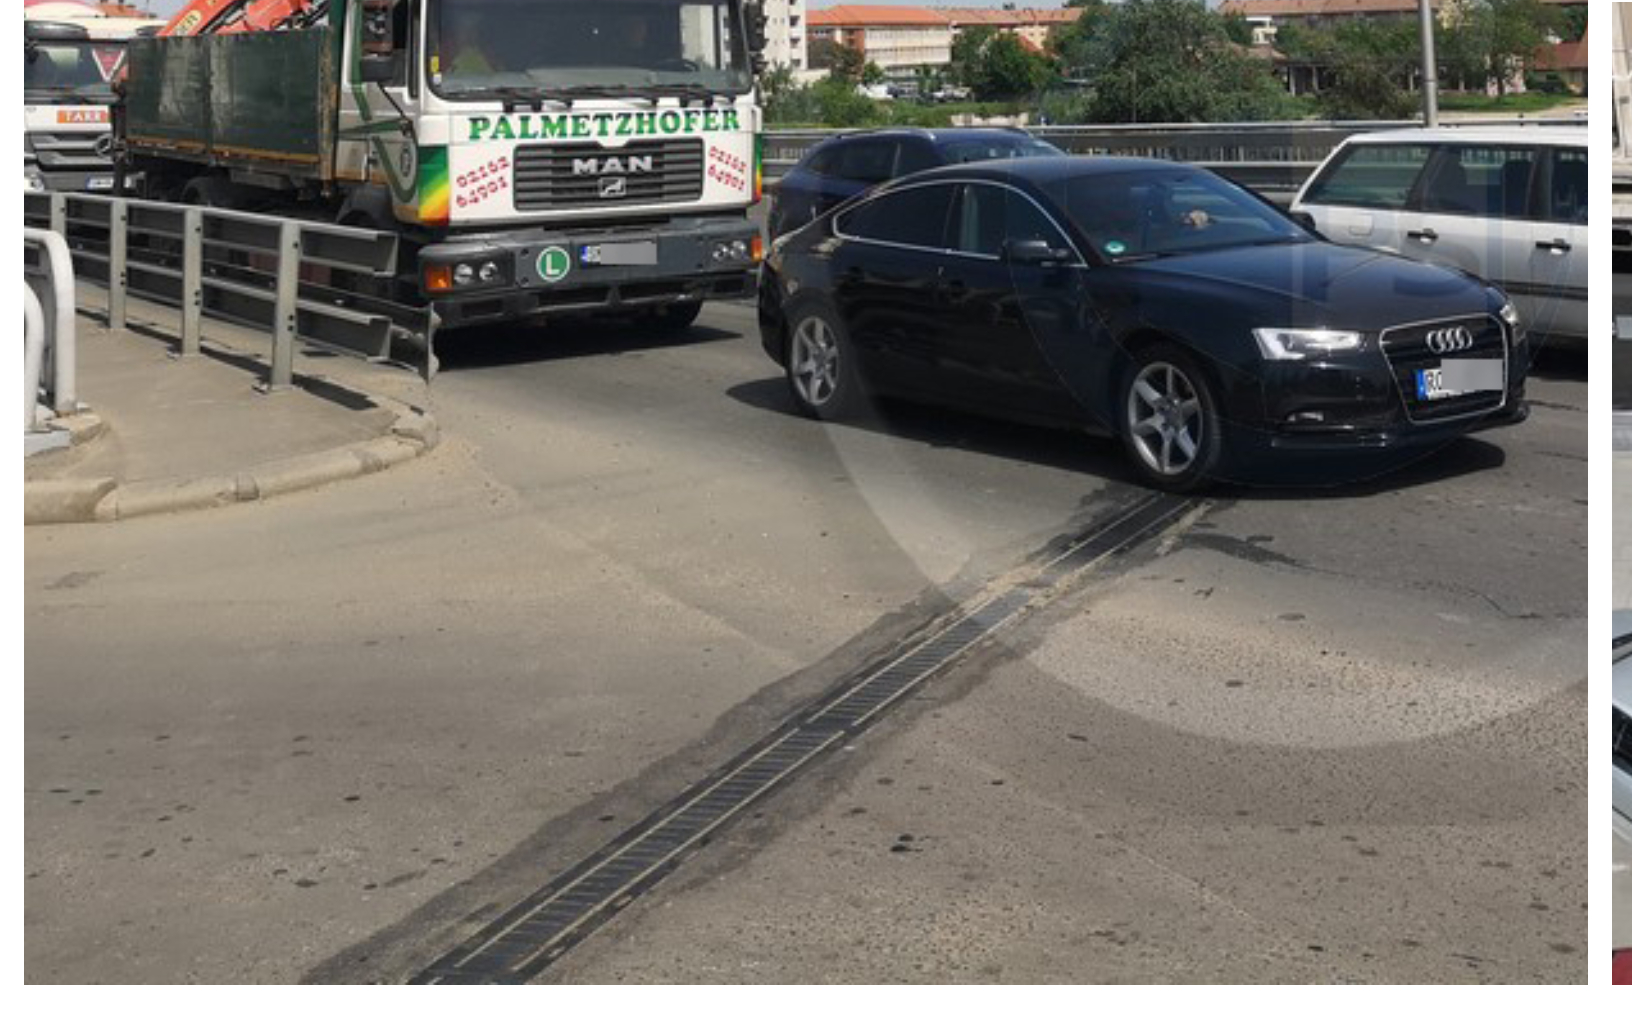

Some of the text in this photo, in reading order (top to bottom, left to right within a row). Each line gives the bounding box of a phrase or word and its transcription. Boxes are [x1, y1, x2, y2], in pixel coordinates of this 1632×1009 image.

[468, 110, 740, 140] PALMETZHOFER
[456, 156, 509, 188] 02162
[572, 156, 653, 174] MAN
[456, 177, 508, 207] 64901
[546, 254, 559, 274] L
